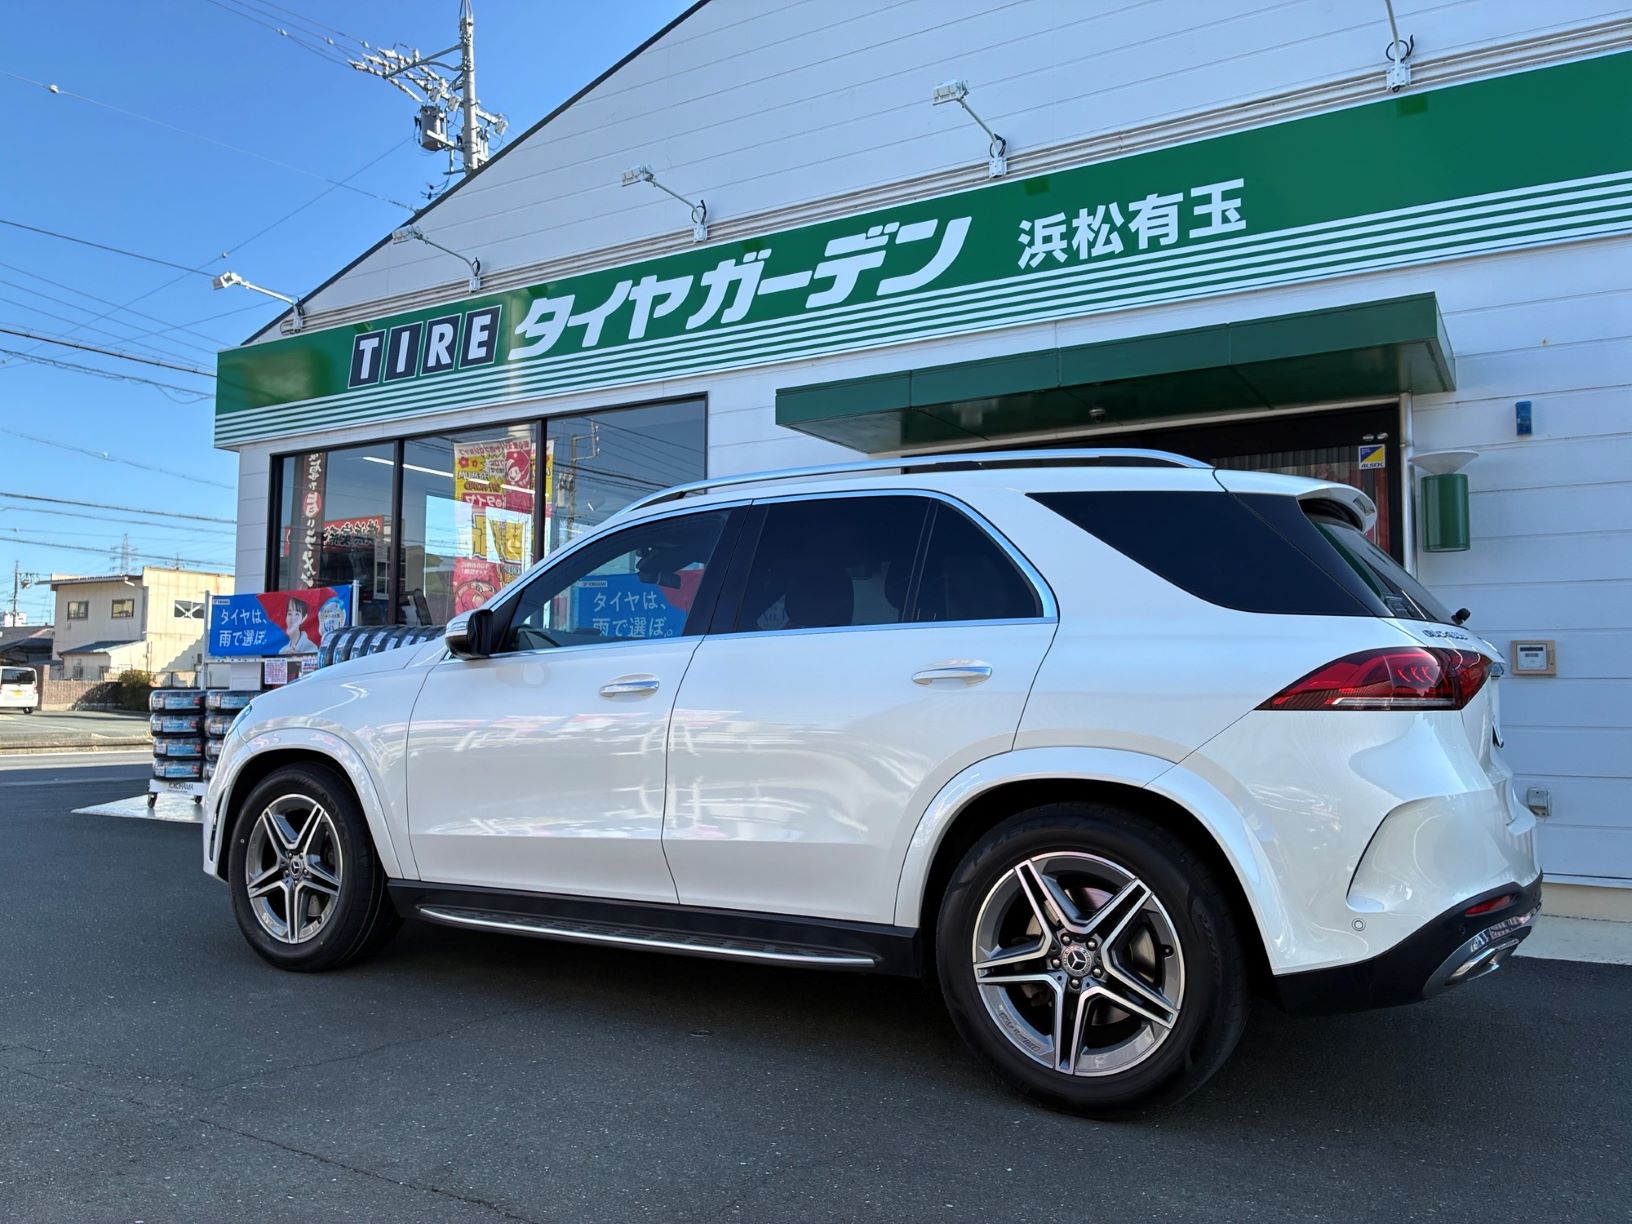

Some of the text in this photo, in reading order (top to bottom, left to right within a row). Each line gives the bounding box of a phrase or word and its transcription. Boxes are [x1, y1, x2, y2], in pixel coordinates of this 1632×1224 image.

[1017, 177, 1247, 270] 浜松有玉
[507, 215, 973, 361] タイヤガーデン
[358, 313, 493, 380] TIRE
[593, 591, 667, 612] タイヤは、
[220, 608, 268, 625] タイヤは、
[592, 616, 673, 638] 雨で選ぼ。
[219, 629, 268, 647] 雨で選ぼ。
